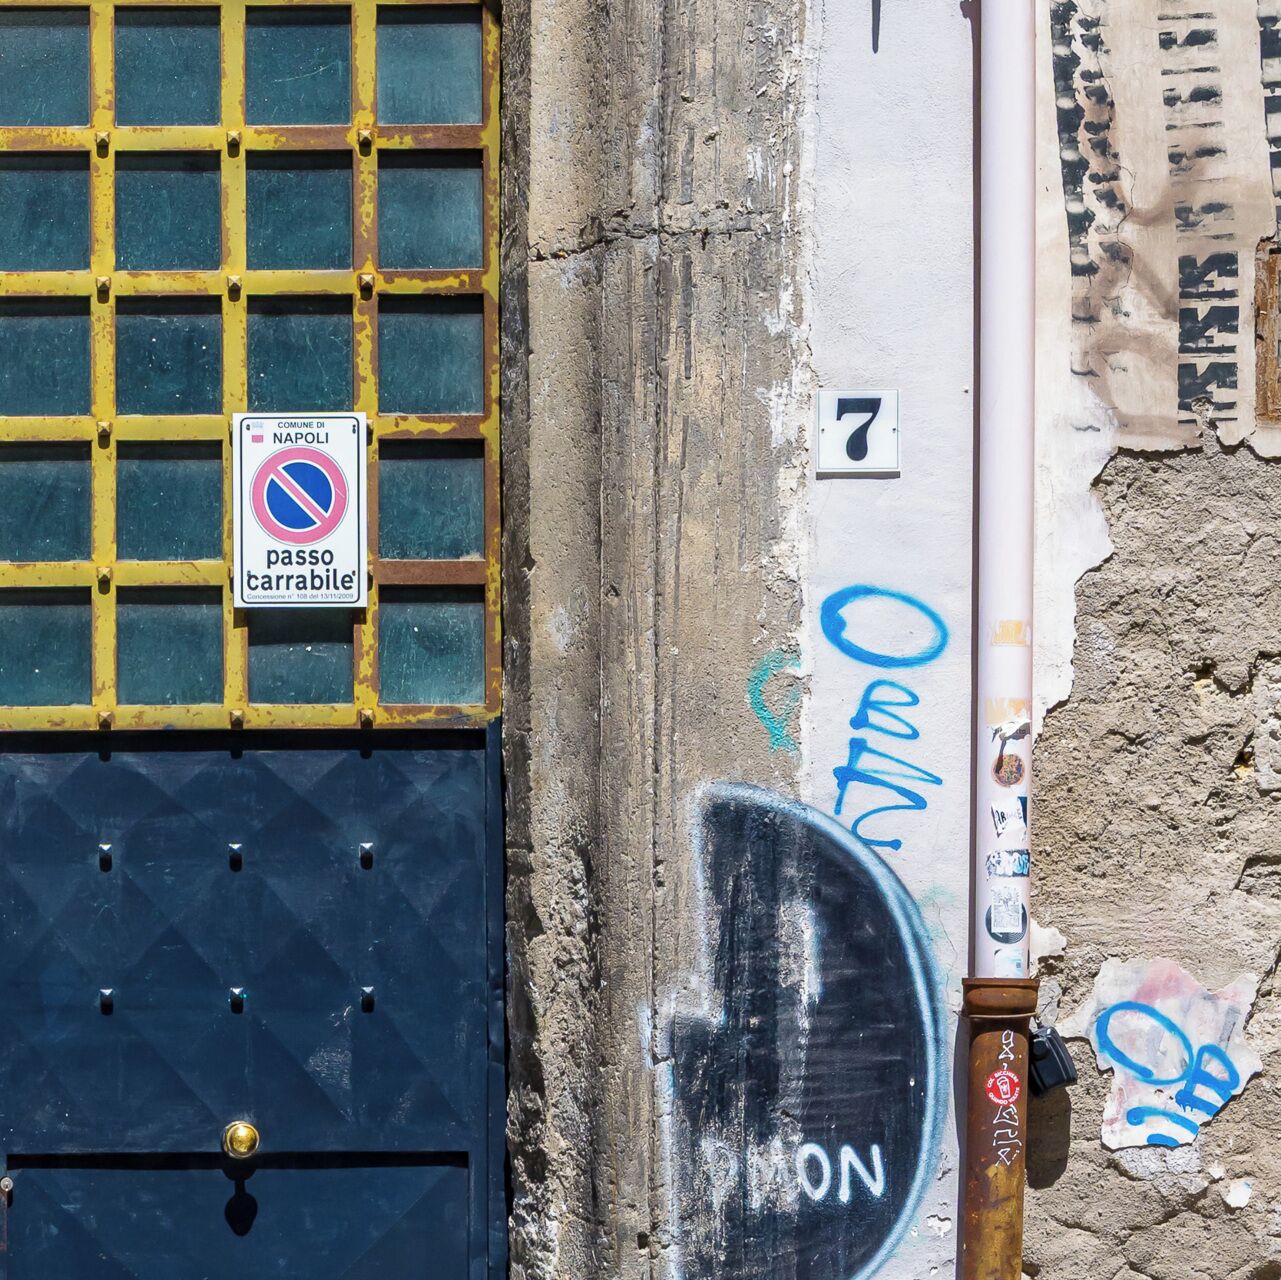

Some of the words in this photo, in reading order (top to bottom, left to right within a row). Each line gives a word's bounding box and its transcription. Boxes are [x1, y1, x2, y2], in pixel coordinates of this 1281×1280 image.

[277, 421, 314, 429] COMUNE
[316, 421, 325, 429] DI
[836, 397, 882, 461] 7
[273, 432, 329, 444] NAPOLI
[266, 549, 334, 569] passo
[246, 568, 354, 591] carrabile
